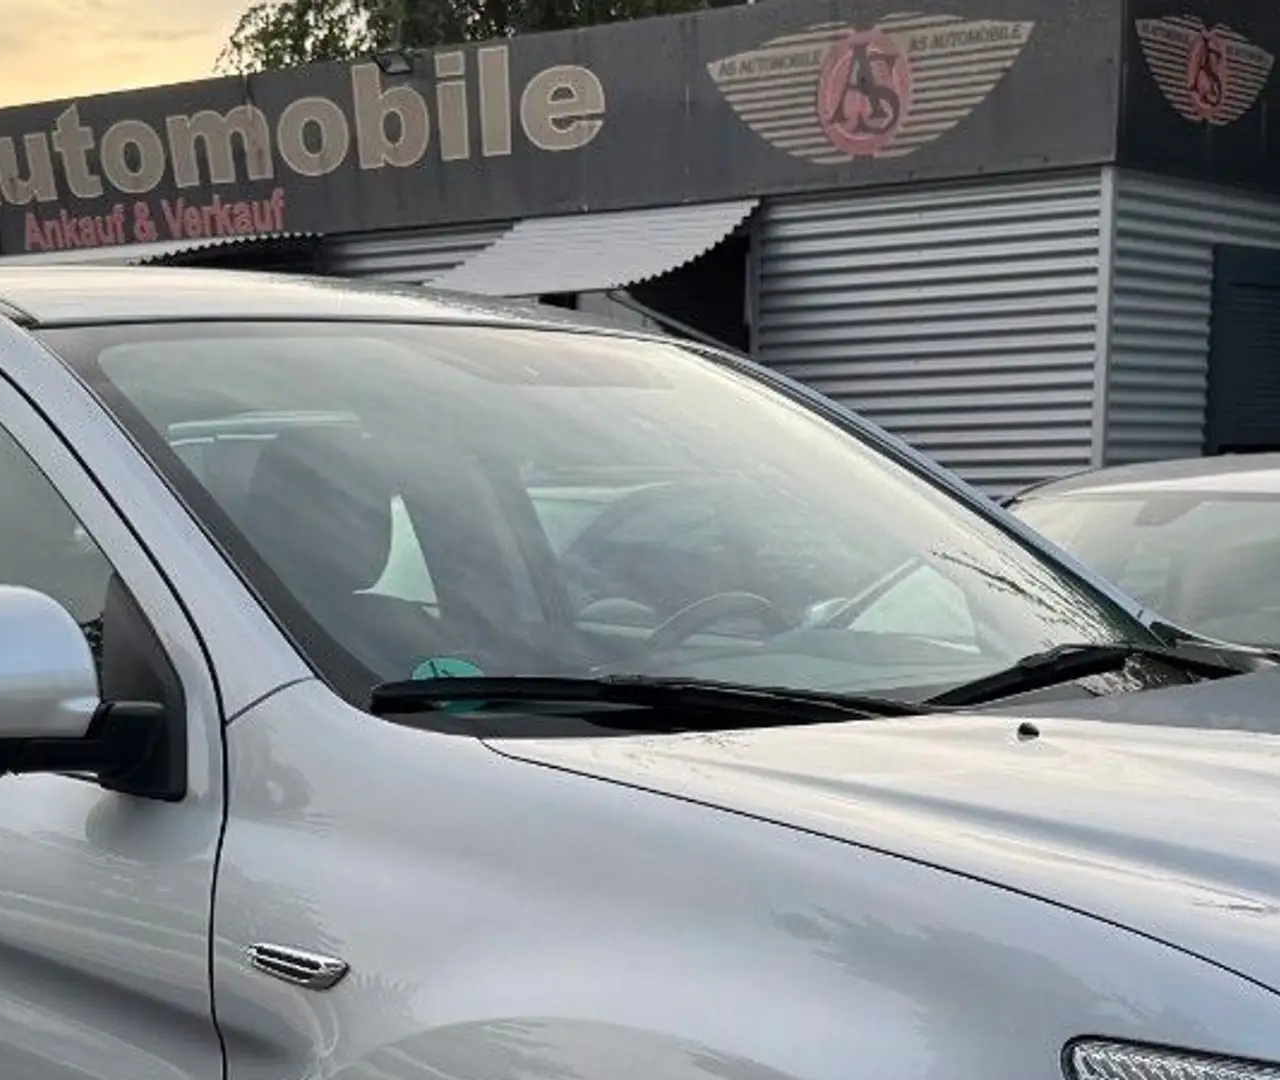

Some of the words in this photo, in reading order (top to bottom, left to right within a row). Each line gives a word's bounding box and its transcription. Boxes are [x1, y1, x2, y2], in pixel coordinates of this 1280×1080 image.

[24, 200, 125, 251] Ankauf
[133, 201, 158, 242] &
[161, 187, 285, 240] Verkauf
